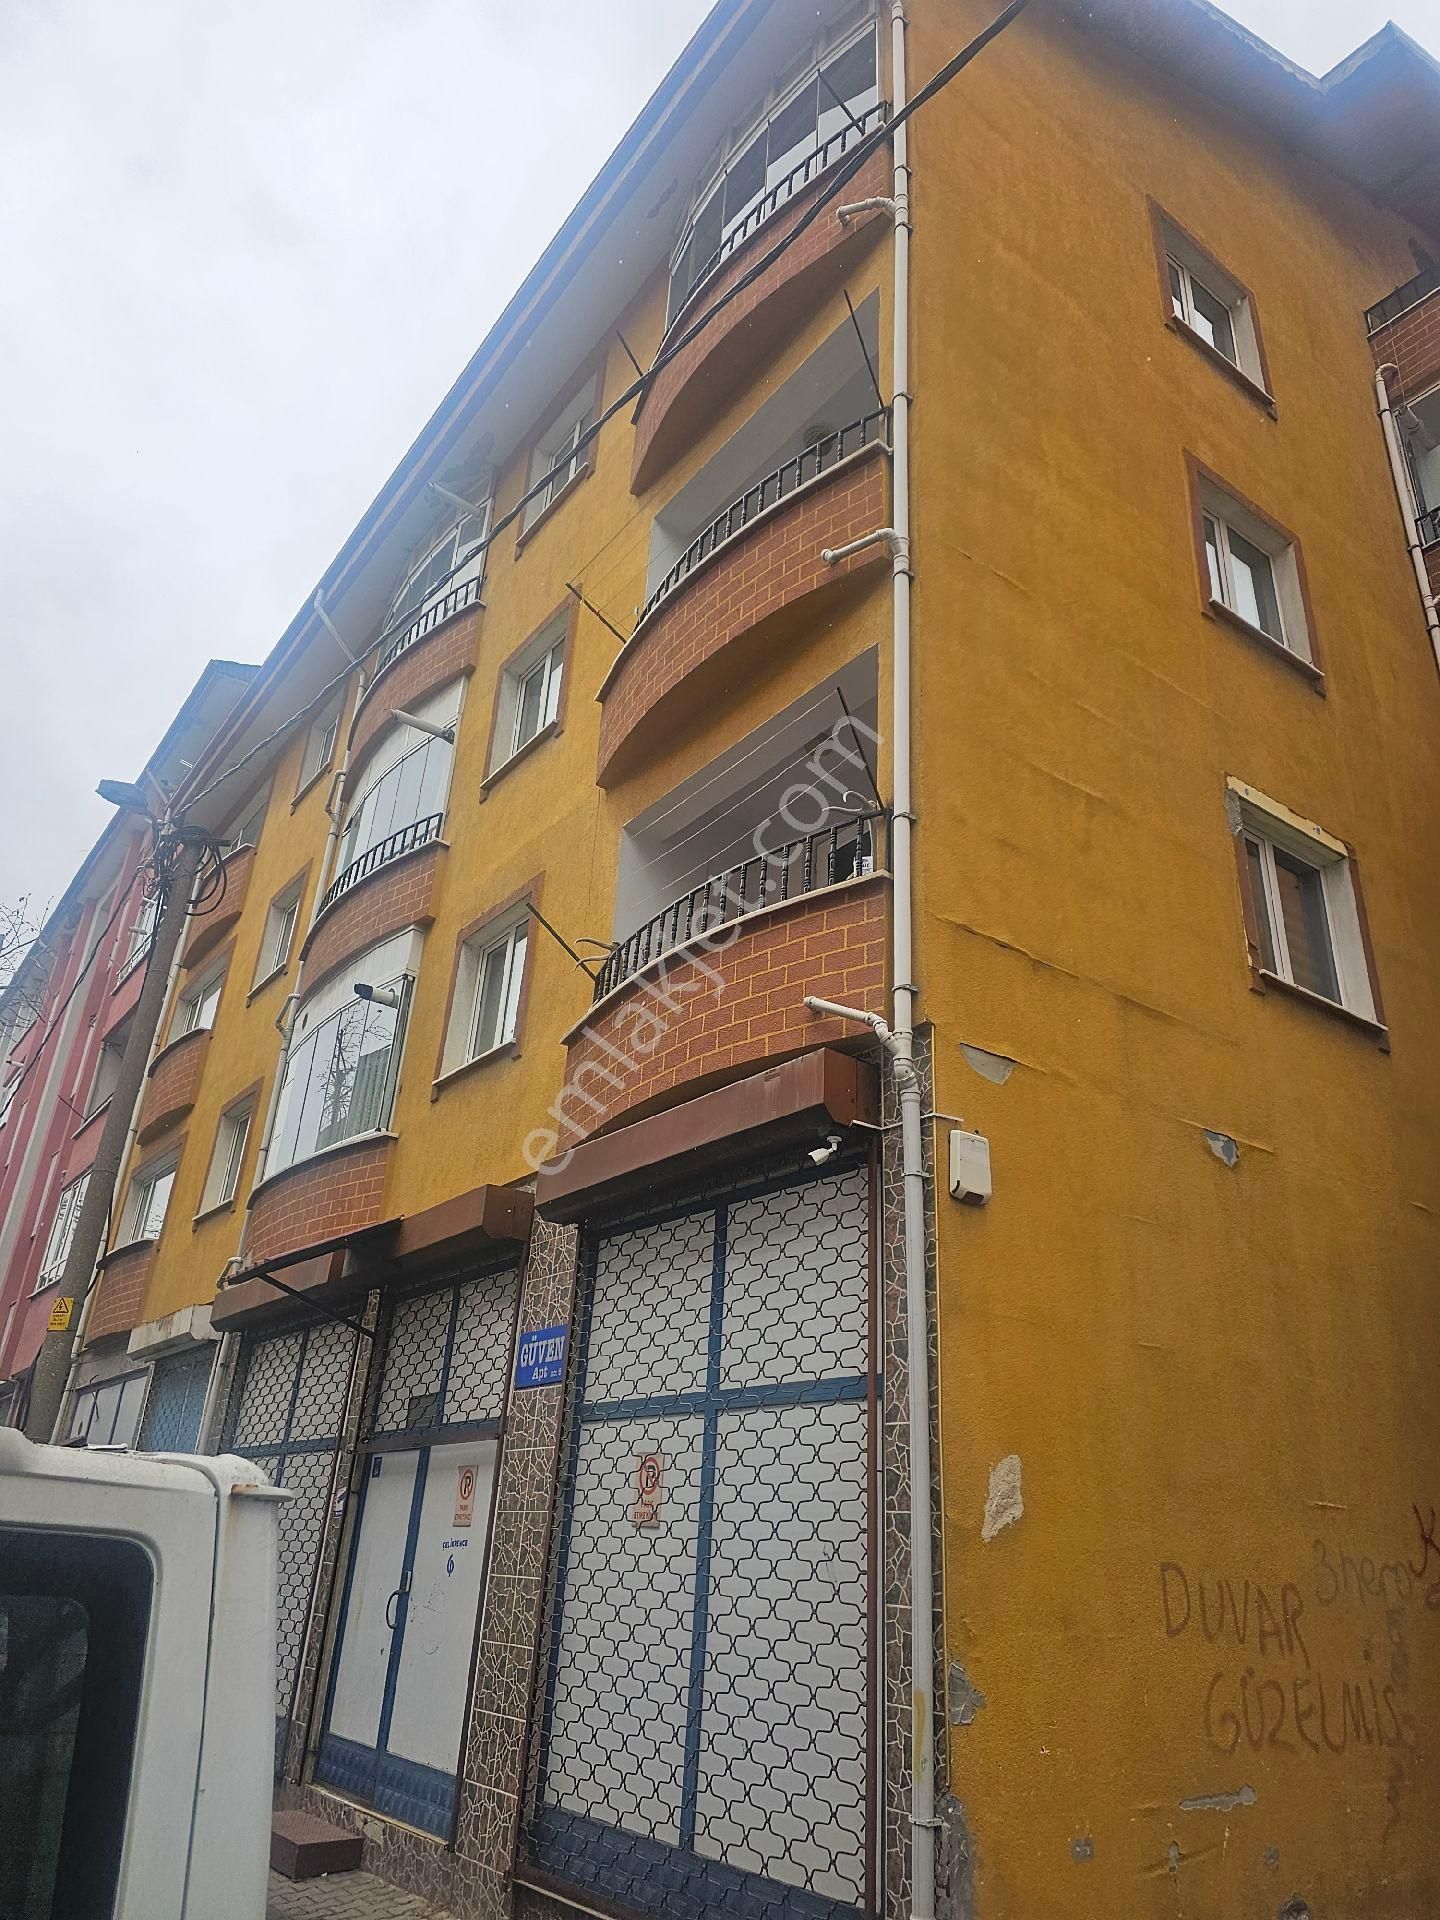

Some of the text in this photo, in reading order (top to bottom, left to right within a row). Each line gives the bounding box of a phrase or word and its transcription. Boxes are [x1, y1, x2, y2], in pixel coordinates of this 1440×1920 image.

[520, 1334, 566, 1368] GÜVEN
[531, 1366, 548, 1381] Apt
[1159, 1560, 1311, 1670] DUVAR
